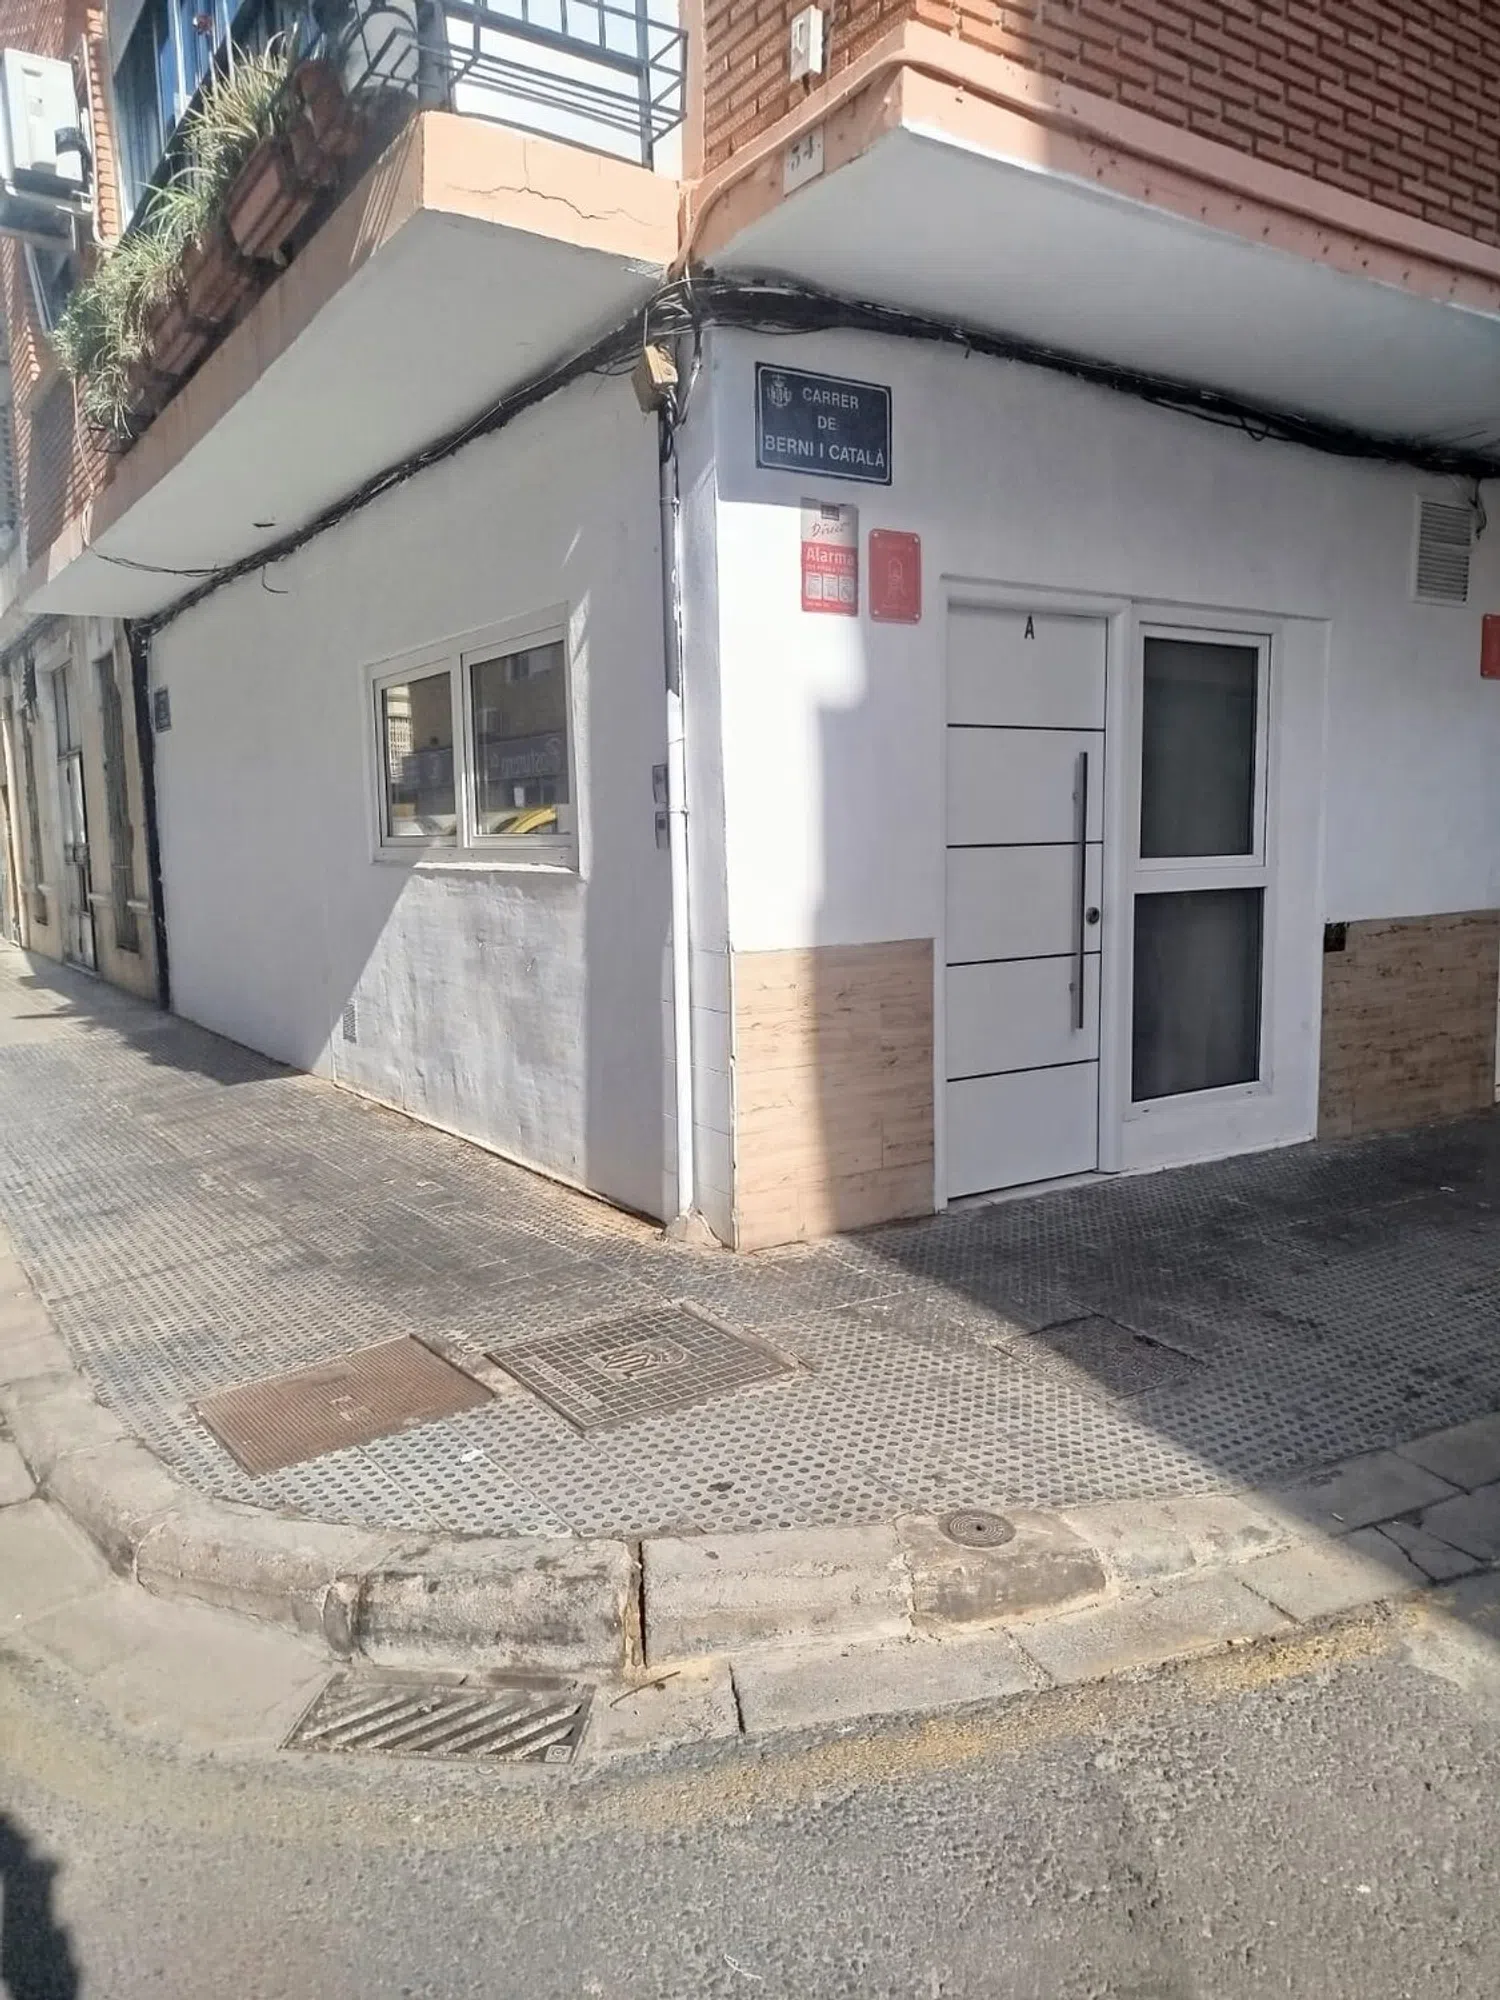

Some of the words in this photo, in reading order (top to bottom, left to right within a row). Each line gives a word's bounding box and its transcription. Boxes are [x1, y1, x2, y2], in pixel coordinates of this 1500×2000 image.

[802, 387, 859, 409] CARRER
[817, 415, 837, 431] DE
[764, 434, 814, 457] BERNI
[819, 442, 824, 458] I
[1024, 613, 1035, 640] A
